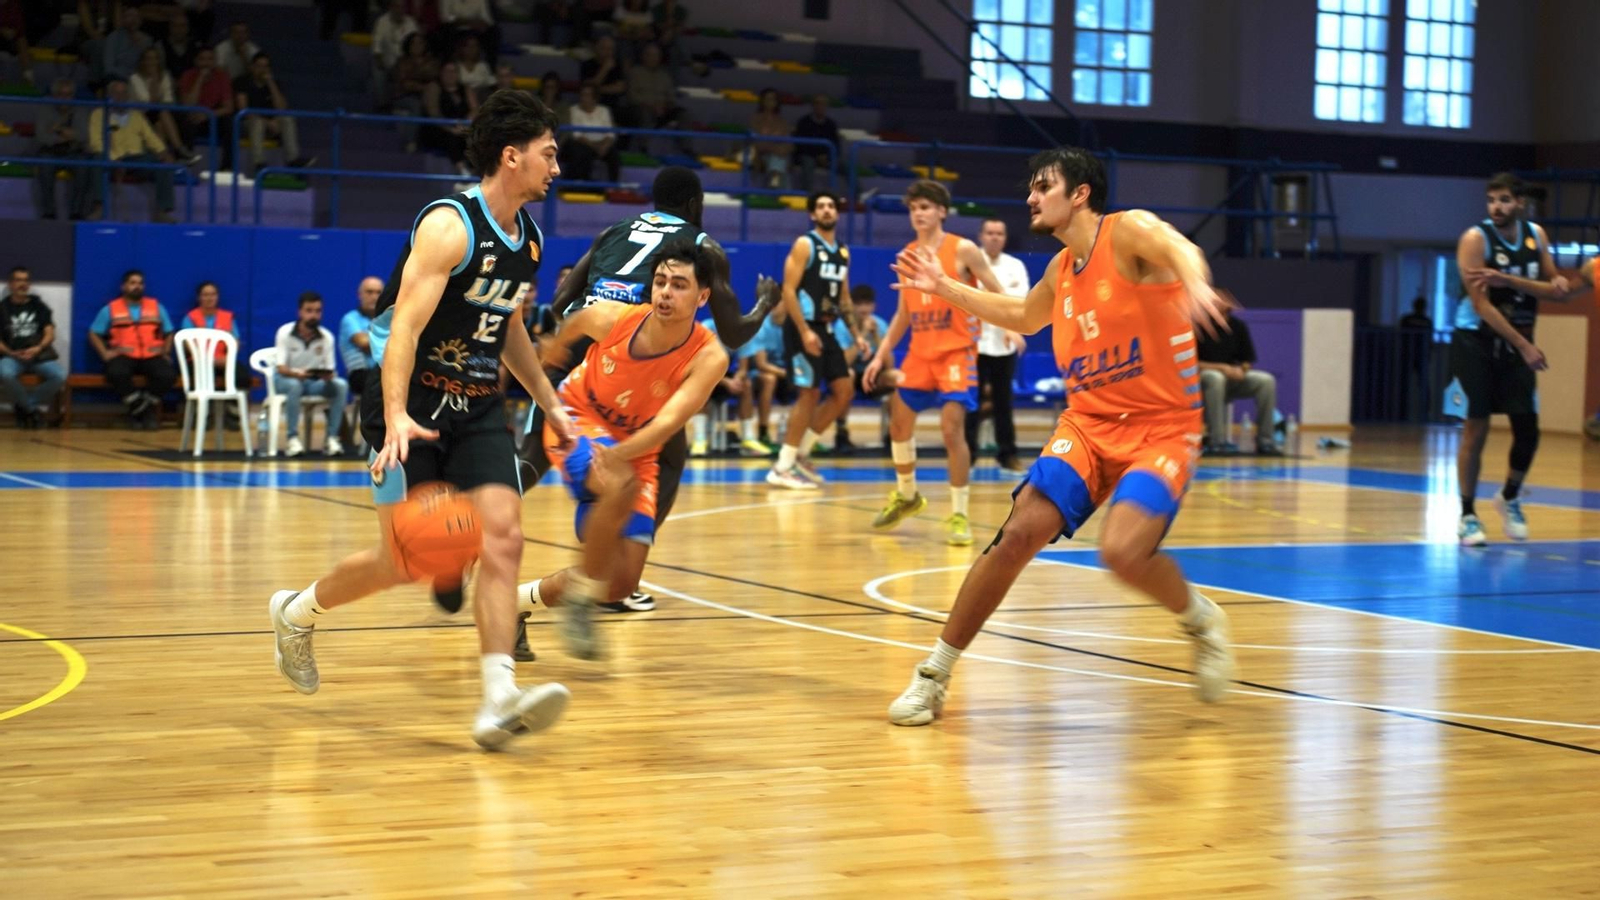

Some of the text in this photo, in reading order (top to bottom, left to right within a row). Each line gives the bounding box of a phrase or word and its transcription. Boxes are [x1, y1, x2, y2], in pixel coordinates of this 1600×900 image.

[615, 230, 664, 275] 7
[473, 313, 504, 344] 12
[1076, 308, 1100, 342] 15
[614, 390, 634, 409] 4
